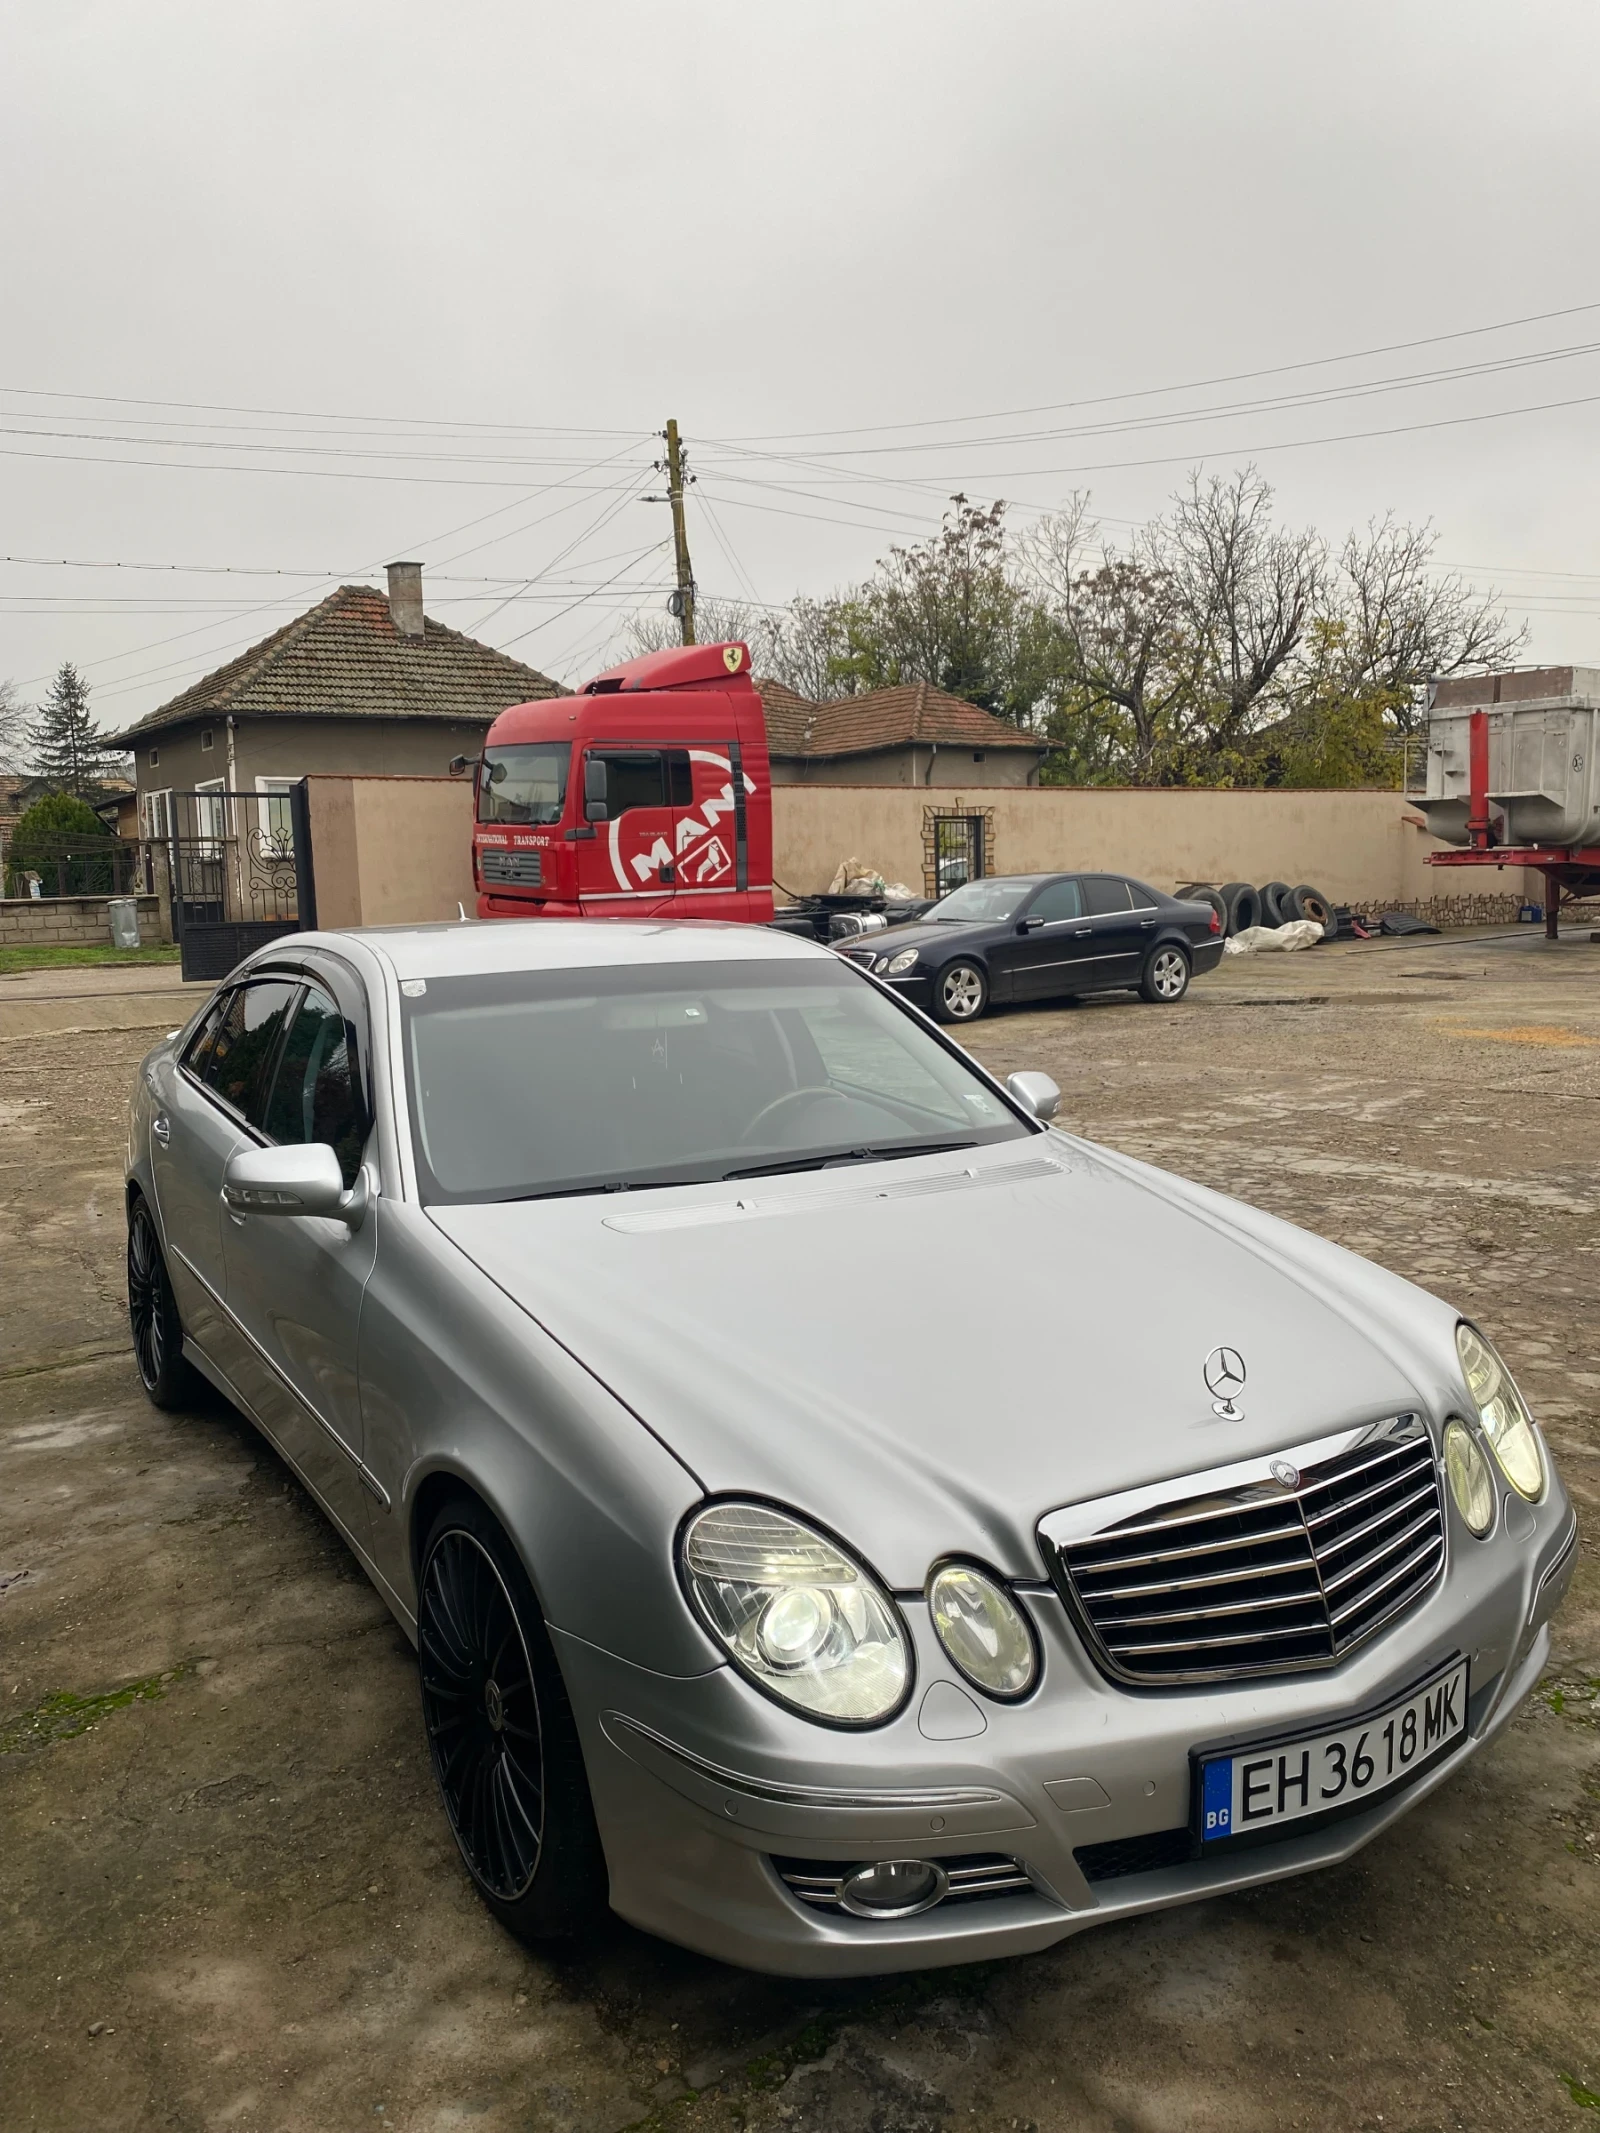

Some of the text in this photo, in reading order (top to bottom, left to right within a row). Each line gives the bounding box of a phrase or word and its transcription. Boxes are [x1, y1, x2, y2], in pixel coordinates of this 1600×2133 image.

[630, 783, 735, 882] MAN
[513, 835, 550, 847] TRANSPORT
[499, 856, 520, 867] MAN
[1206, 1808, 1229, 1829] BG
